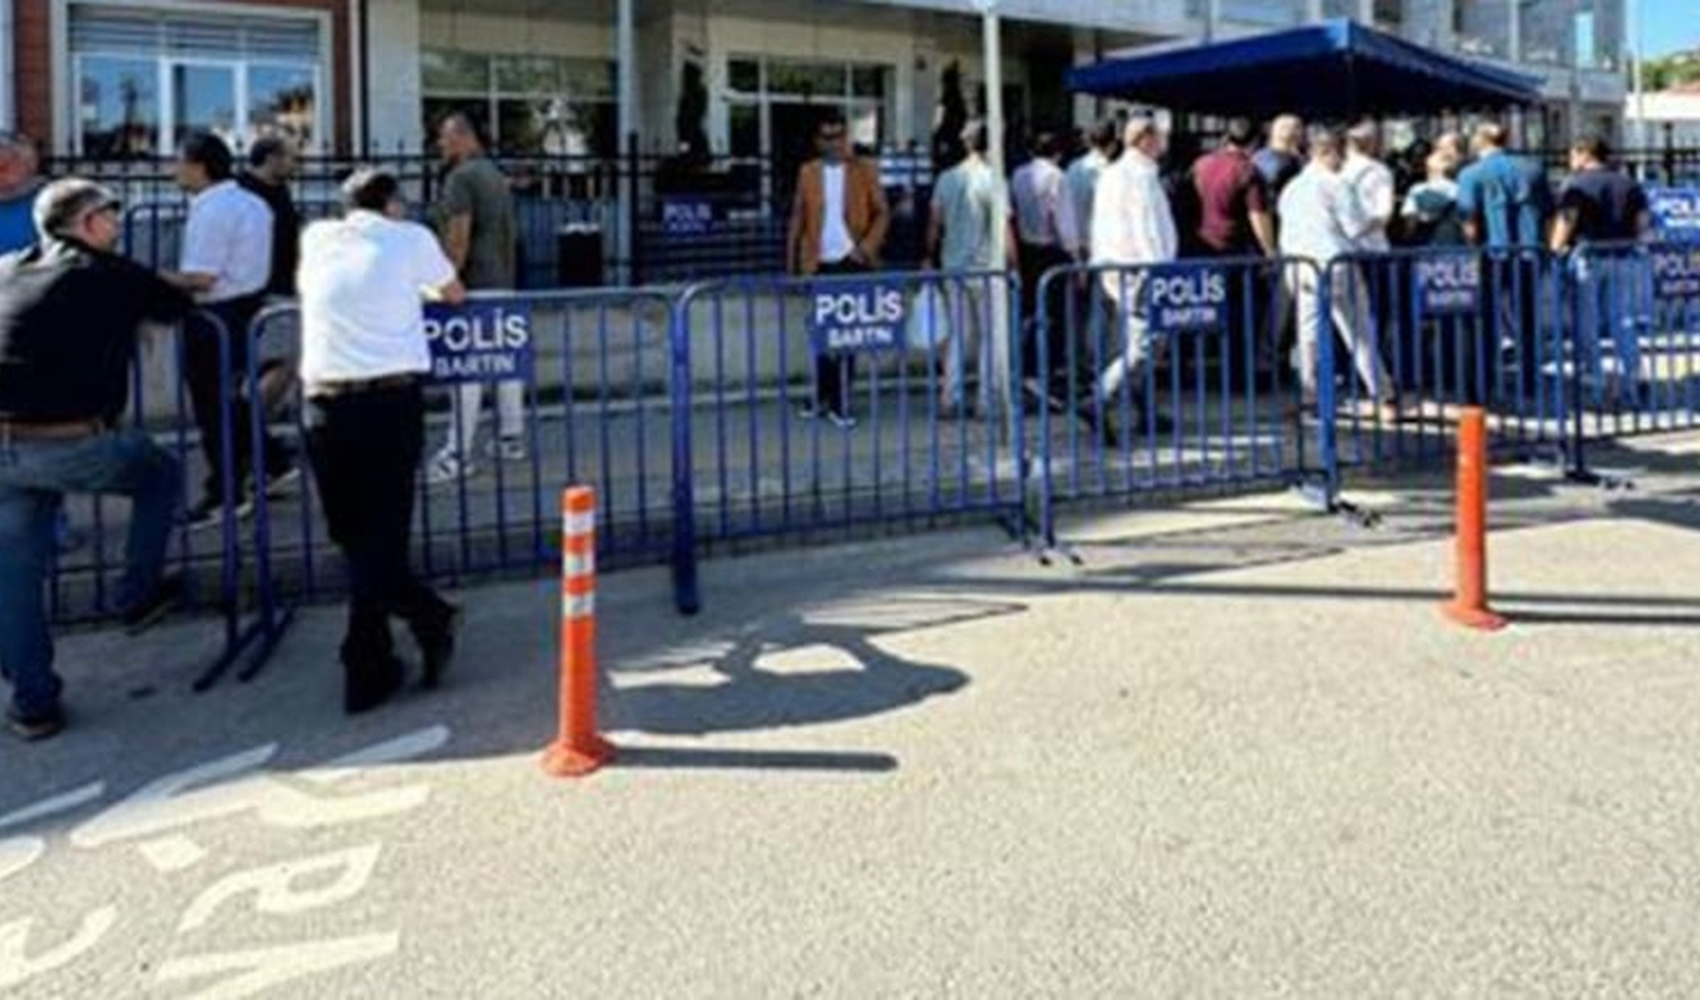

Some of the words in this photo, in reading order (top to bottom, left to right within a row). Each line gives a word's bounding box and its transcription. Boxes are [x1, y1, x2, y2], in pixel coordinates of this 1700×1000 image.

[815, 286, 903, 325] POLİS
[1151, 268, 1225, 307] POLİS
[423, 307, 529, 351] POLİS
[434, 353, 516, 378] BARTIN
